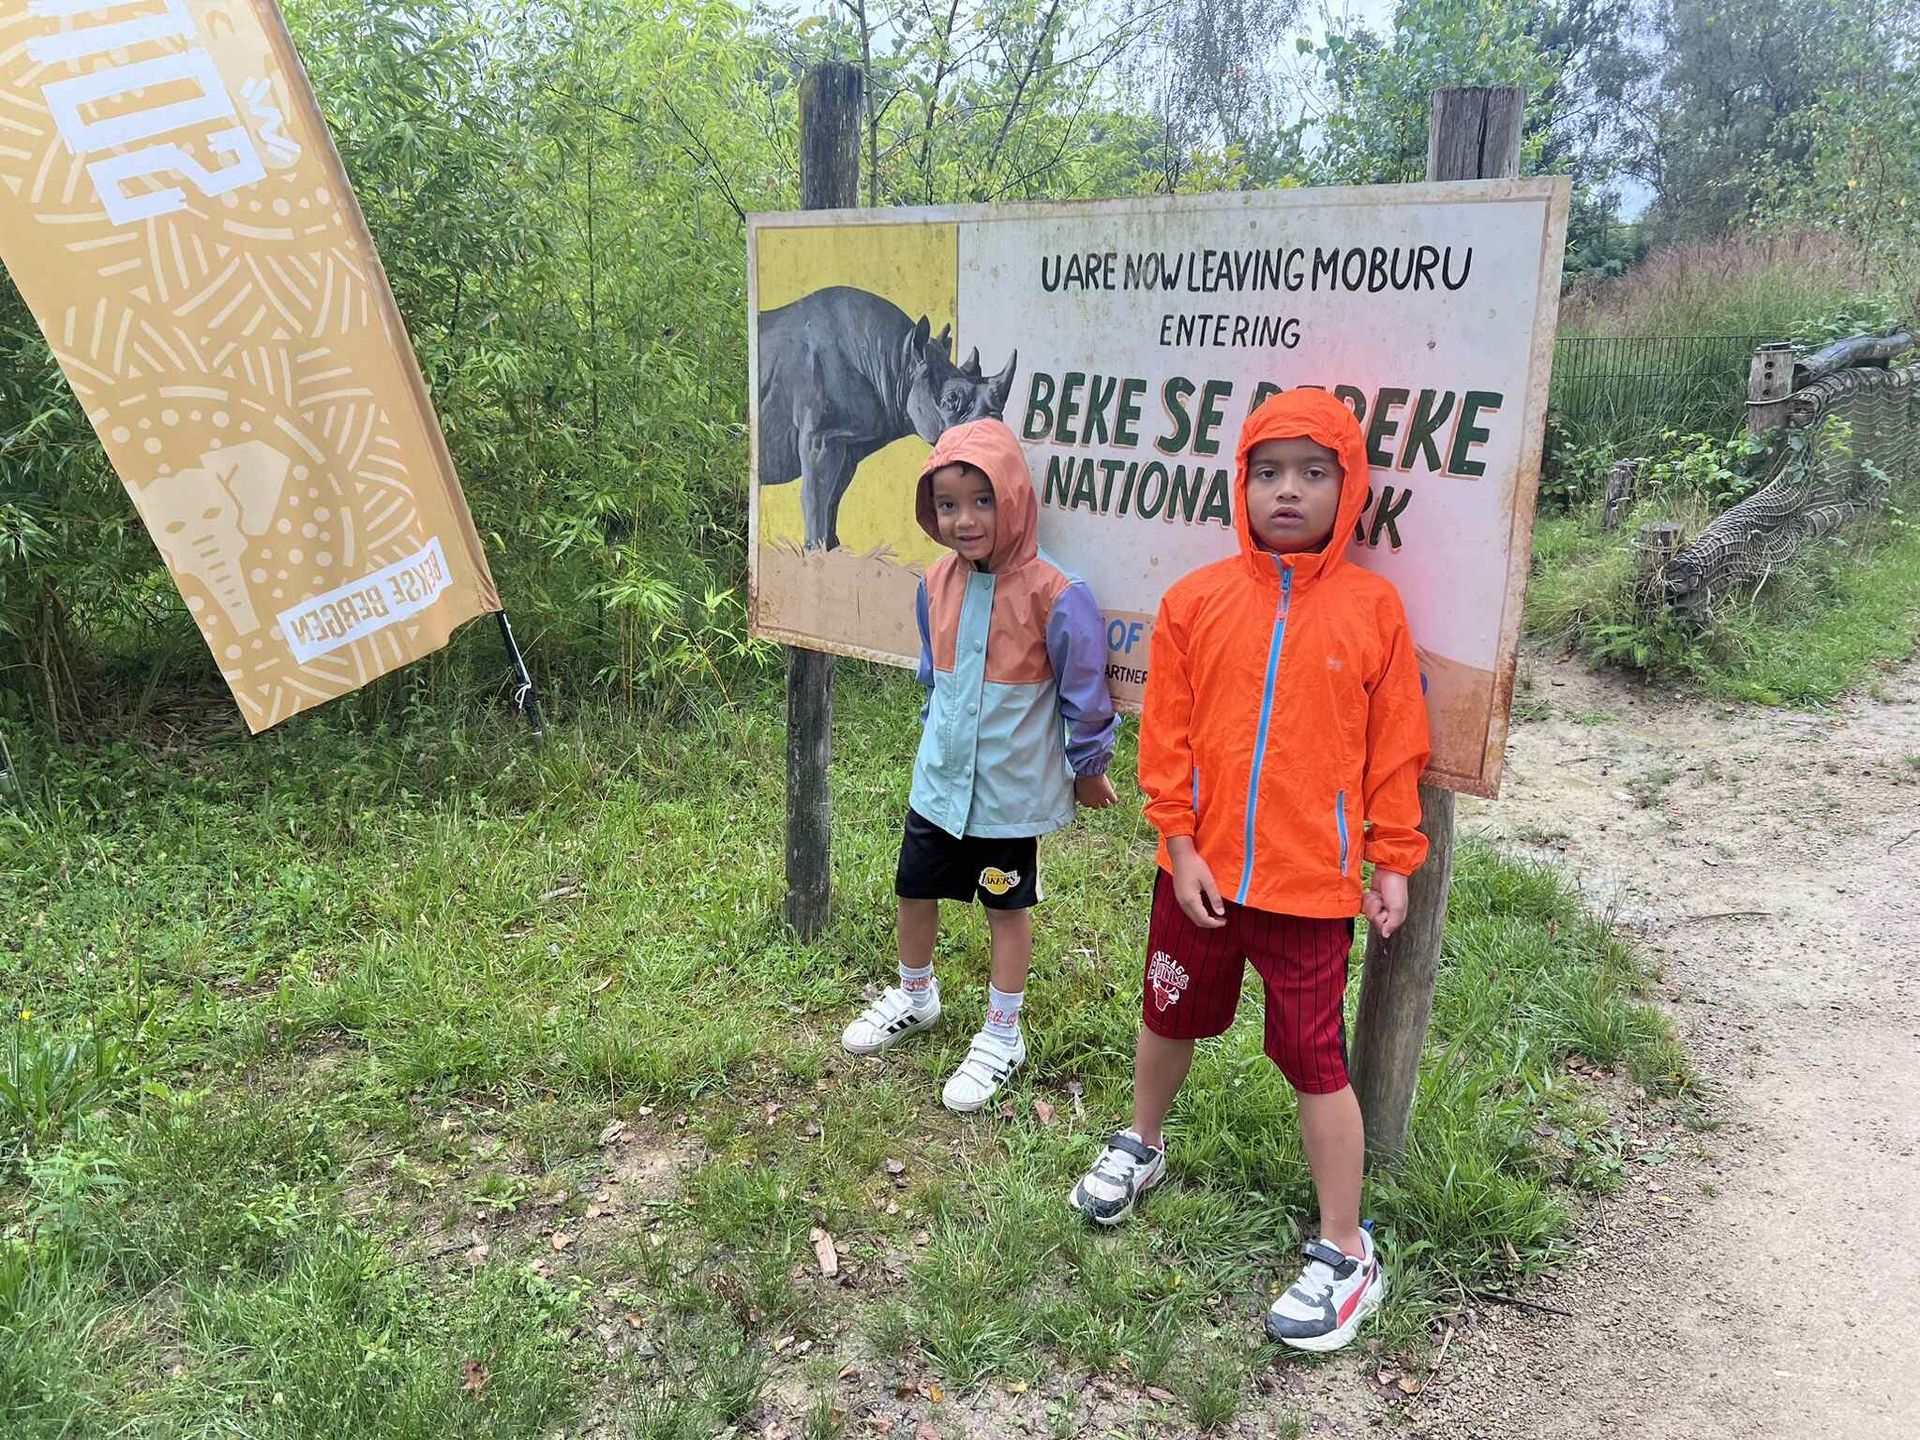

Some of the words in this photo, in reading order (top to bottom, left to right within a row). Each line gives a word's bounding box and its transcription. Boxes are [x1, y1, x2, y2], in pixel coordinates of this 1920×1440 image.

[1123, 252, 1184, 291] NOW
[1187, 248, 1305, 292] LEAVING
[1311, 244, 1473, 292] MOBURU
[1160, 314, 1300, 349] ENTERING
[1020, 371, 1147, 450] BEKE
[1155, 376, 1233, 456] SE
[1043, 454, 1233, 527] NATIONA
[1107, 618, 1144, 654] OF
